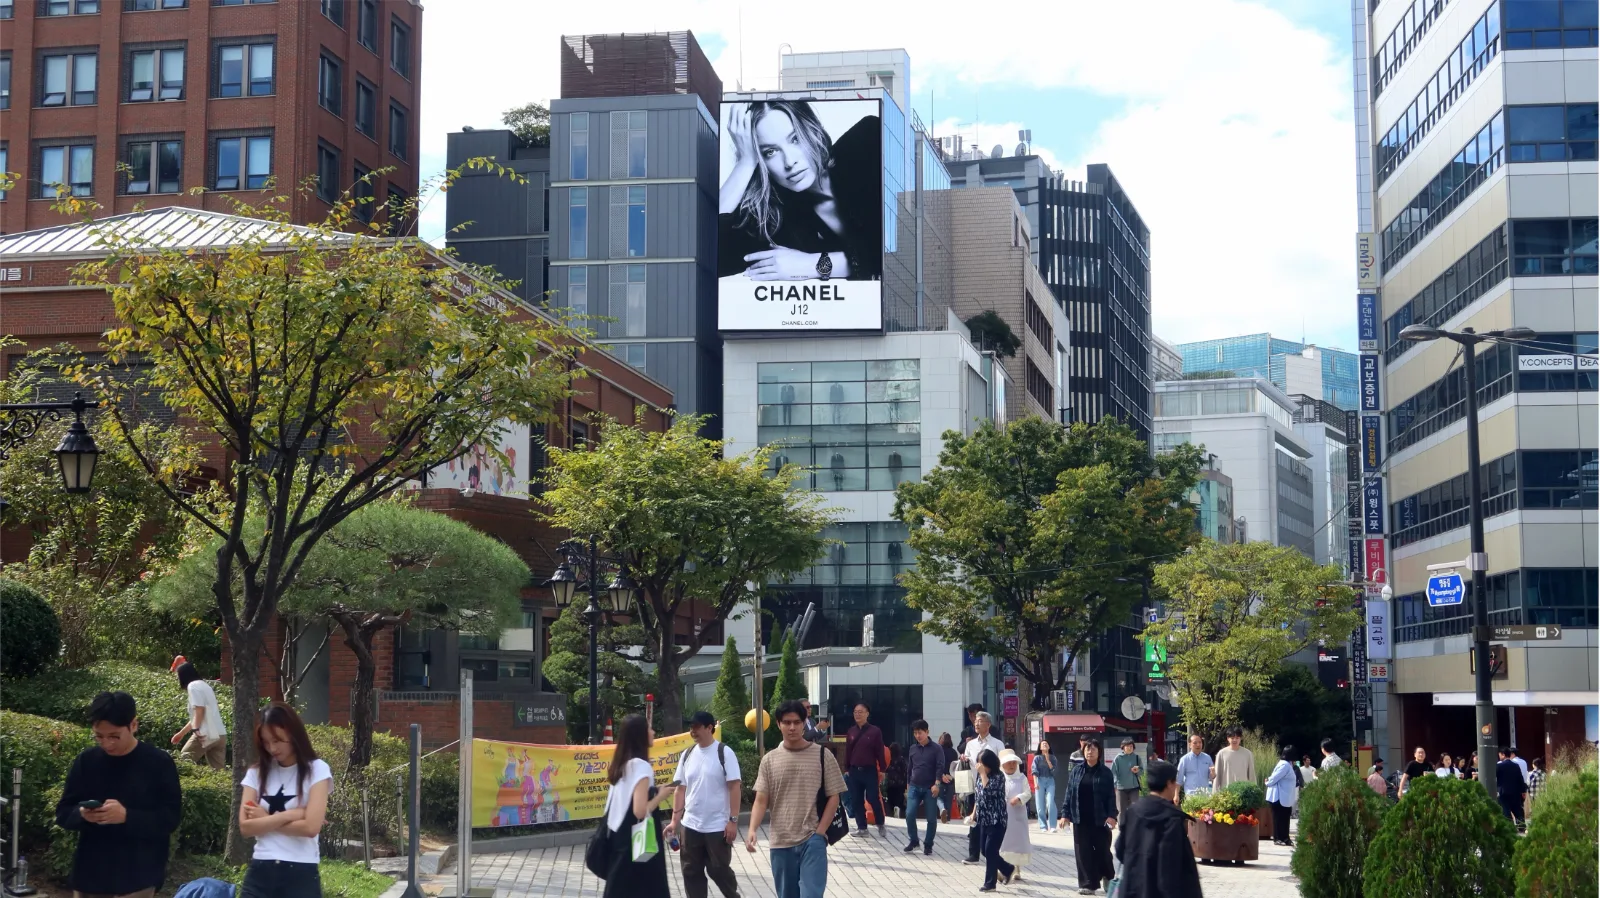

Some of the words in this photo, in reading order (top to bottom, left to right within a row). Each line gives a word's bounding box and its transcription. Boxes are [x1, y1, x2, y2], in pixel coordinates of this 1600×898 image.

[1359, 236, 1375, 279] TEMPIS
[754, 285, 845, 301] CHANEL
[790, 304, 809, 315] J12
[1362, 297, 1373, 338] 루덴치과
[1520, 358, 1573, 367] Y.CONCEPTS
[1364, 358, 1375, 408] 교보증권
[1370, 666, 1387, 677] 공증
